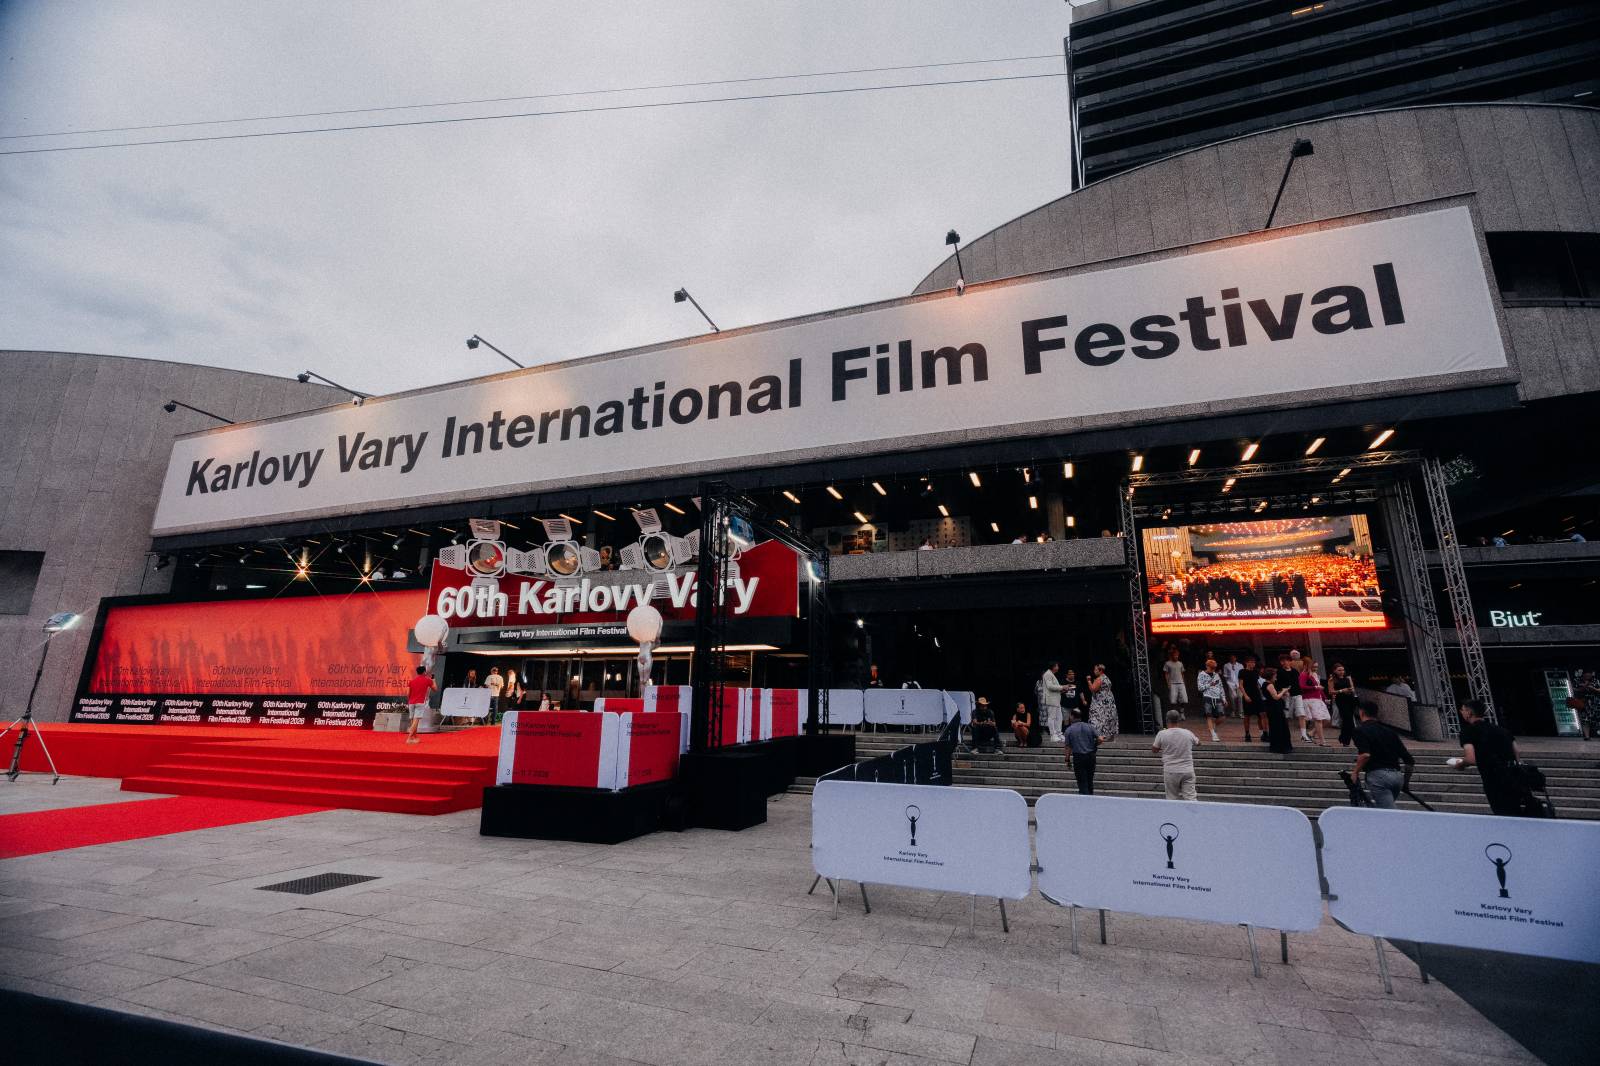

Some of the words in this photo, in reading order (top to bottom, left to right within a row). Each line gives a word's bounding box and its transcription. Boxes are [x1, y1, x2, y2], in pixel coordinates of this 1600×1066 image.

[186, 448, 325, 497] Karlovy
[338, 431, 429, 474] Vary
[442, 357, 801, 460] International
[832, 339, 989, 402] Film
[1021, 262, 1406, 375] Festival
[437, 582, 509, 619] 60th
[518, 577, 655, 615] Karlovy
[500, 630, 520, 640] Karlovy
[521, 629, 535, 639] Vary
[536, 628, 578, 638] International
[579, 627, 596, 636] Film
[597, 626, 627, 636] Festival
[328, 663, 350, 674] 60th
[351, 663, 384, 676] Karlovy
[387, 663, 408, 676] Vary
[331, 702, 352, 710] Karlovy
[352, 702, 365, 711] Vary
[376, 702, 391, 710] 60th
[323, 710, 357, 718] International
[313, 718, 326, 726] Film
[326, 718, 347, 726] Festival
[1132, 880, 1171, 888] International
[1480, 903, 1512, 913] Karlovy
[1514, 907, 1533, 915] Vary
[1454, 909, 1507, 920] International
[1509, 915, 1527, 923] Film
[1529, 918, 1564, 927] Festival
